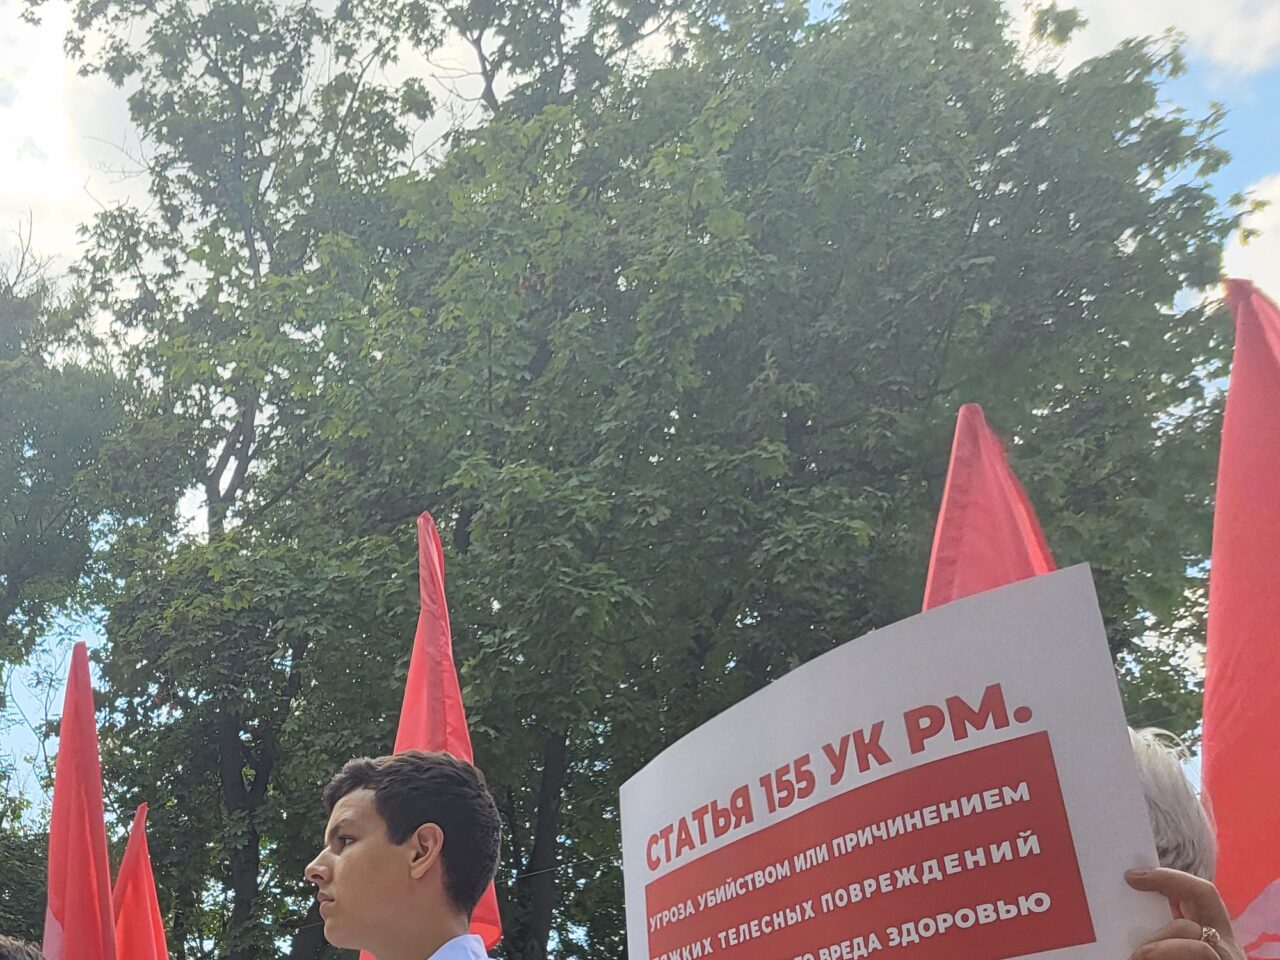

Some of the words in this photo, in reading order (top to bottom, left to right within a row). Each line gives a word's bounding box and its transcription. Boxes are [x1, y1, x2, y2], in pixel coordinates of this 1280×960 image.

[646, 784, 754, 872] СТАТЬЯ
[759, 753, 816, 815] 155
[821, 720, 892, 786] УК
[903, 683, 1033, 754] РМ.
[649, 901, 696, 933] УГРОЗА
[697, 859, 791, 913] УБИЙСТВОМ
[794, 842, 830, 875] ИЛИ
[832, 781, 1031, 858] ПРИЧИНЕНИЕМ
[718, 899, 816, 949] ТЕЛЕСНЫХ
[821, 830, 1041, 914] ПОВРЕЖДЕНИЙ
[887, 892, 1051, 948] ЗДОРОВЬЮ
